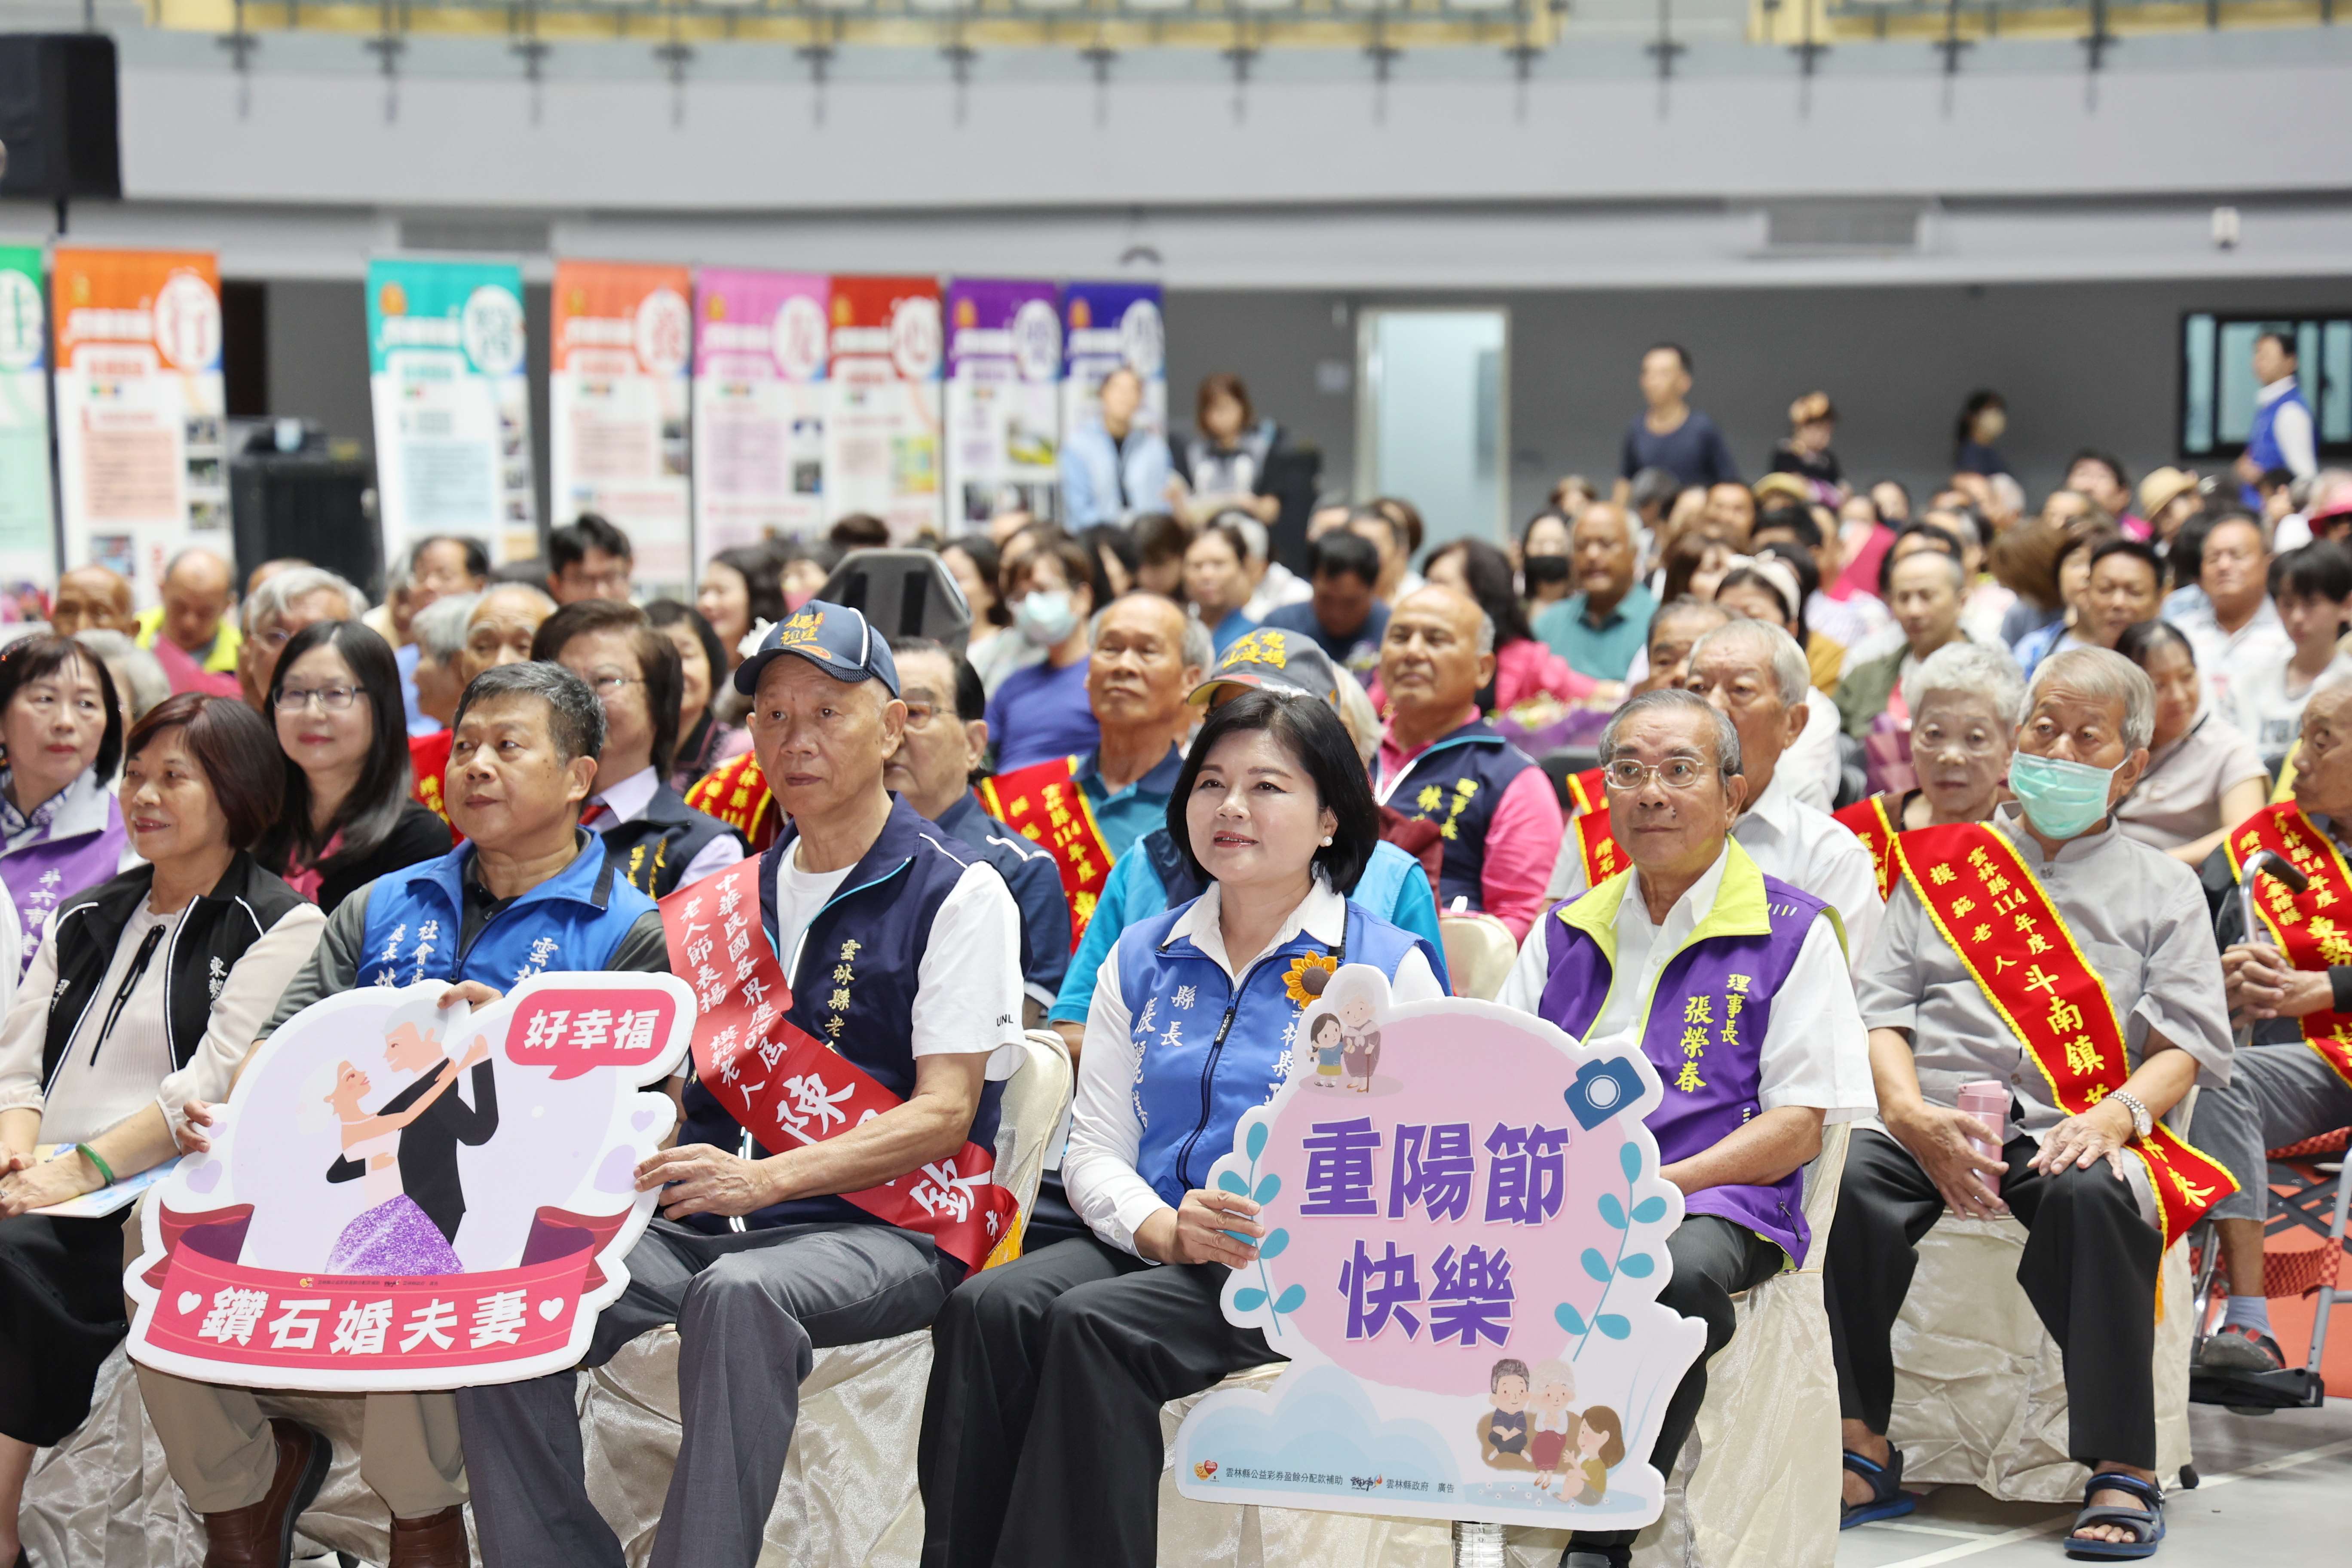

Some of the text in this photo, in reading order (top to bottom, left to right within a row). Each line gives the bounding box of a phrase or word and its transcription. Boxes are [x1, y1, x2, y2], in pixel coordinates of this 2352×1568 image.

[1929, 862, 2018, 976] 模範老人
[1967, 845, 2055, 956] 雲林縣114年度
[522, 1007, 661, 1050] 好幸福
[680, 895, 766, 1112] 老人節表揚 模範老人
[1160, 984, 1198, 1047] 縣長
[1673, 994, 1715, 1093] 張榮春
[1719, 972, 1753, 1047] 理事長
[775, 1072, 992, 1223] 陳欽
[1297, 1115, 1571, 1228] 重陽節
[197, 1284, 528, 1358] 鑽石婚夫妻
[1336, 1237, 1518, 1350] 快樂
[1225, 1467, 1343, 1485] 雲林縣公益彩券盈餘分配款補助
[1386, 1479, 1455, 1494] 雲林縣政府 廣告
